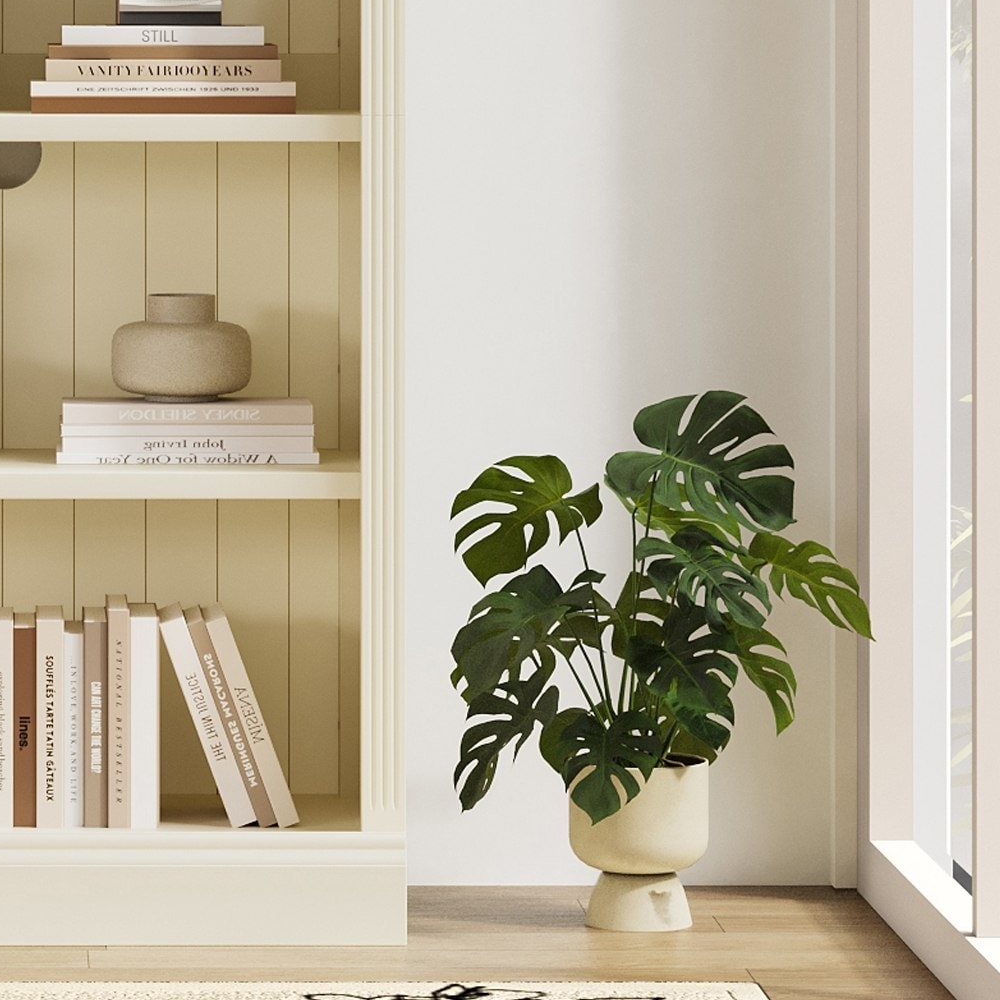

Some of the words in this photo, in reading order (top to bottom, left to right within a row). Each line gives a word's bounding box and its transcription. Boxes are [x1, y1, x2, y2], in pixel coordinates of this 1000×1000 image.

[142, 30, 178, 42] STILL
[77, 65, 131, 76] VANITY
[46, 655, 56, 698] SOUFFLÉS
[115, 639, 123, 708] NATIONAL
[91, 682, 102, 695] CAN
[46, 701, 54, 728] TARTE
[91, 696, 102, 708] ART
[19, 716, 31, 751] lines.
[91, 709, 102, 733] CHANGE
[46, 732, 54, 757] TATIN
[91, 735, 102, 747] THE
[91, 748, 102, 773] WORLD?
[115, 717, 123, 804] BESTSELLER
[46, 761, 56, 801] GÂTEAUX
